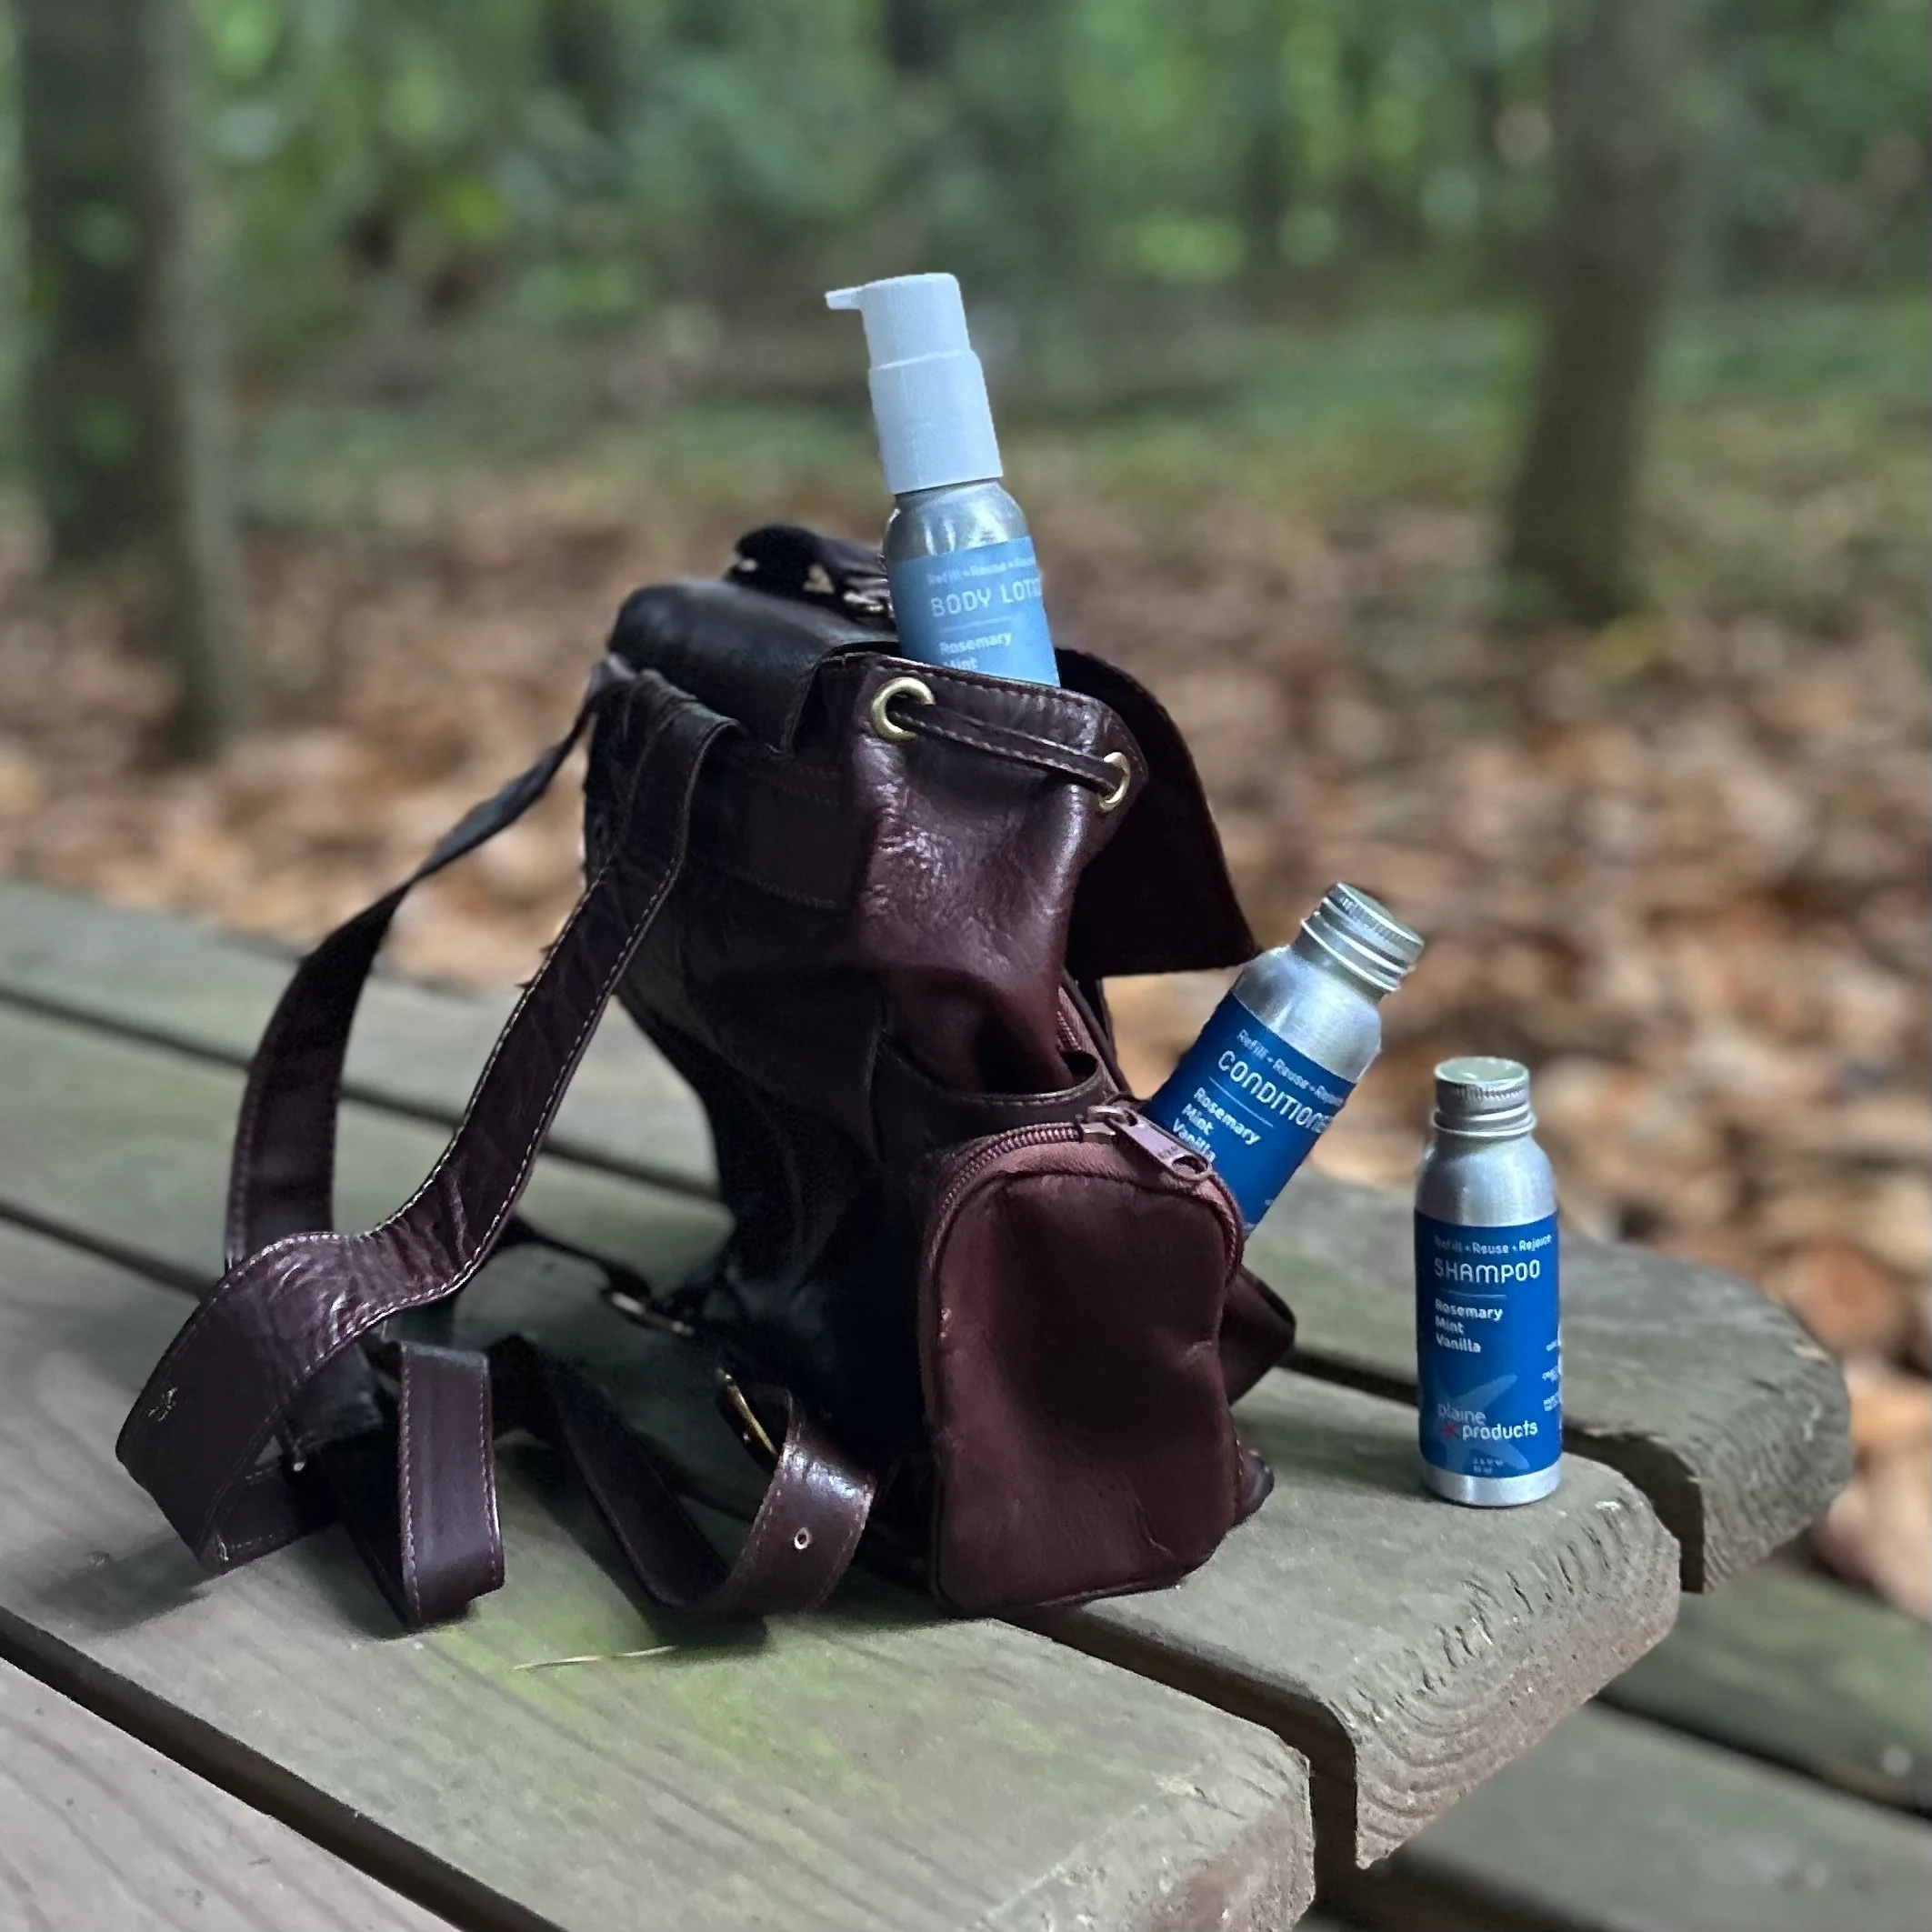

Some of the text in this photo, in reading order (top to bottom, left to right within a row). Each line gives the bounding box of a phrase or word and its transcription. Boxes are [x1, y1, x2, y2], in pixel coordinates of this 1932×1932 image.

[930, 586, 992, 617] BODY
[939, 632, 1012, 656] Rosemary
[1236, 1028, 1310, 1090] Refill Reuse
[1182, 1103, 1215, 1136] Mint
[1194, 1087, 1261, 1146] Rosemary
[1172, 1117, 1216, 1163] Vanilla
[1472, 1241, 1509, 1255] Reuse
[1434, 1257, 1541, 1284] SHAMPOO
[1435, 1297, 1503, 1322] Rosemary
[1435, 1315, 1465, 1335] Mint
[1436, 1332, 1482, 1353] Vanilla
[1436, 1402, 1487, 1426] plaine
[1462, 1419, 1538, 1440] products
